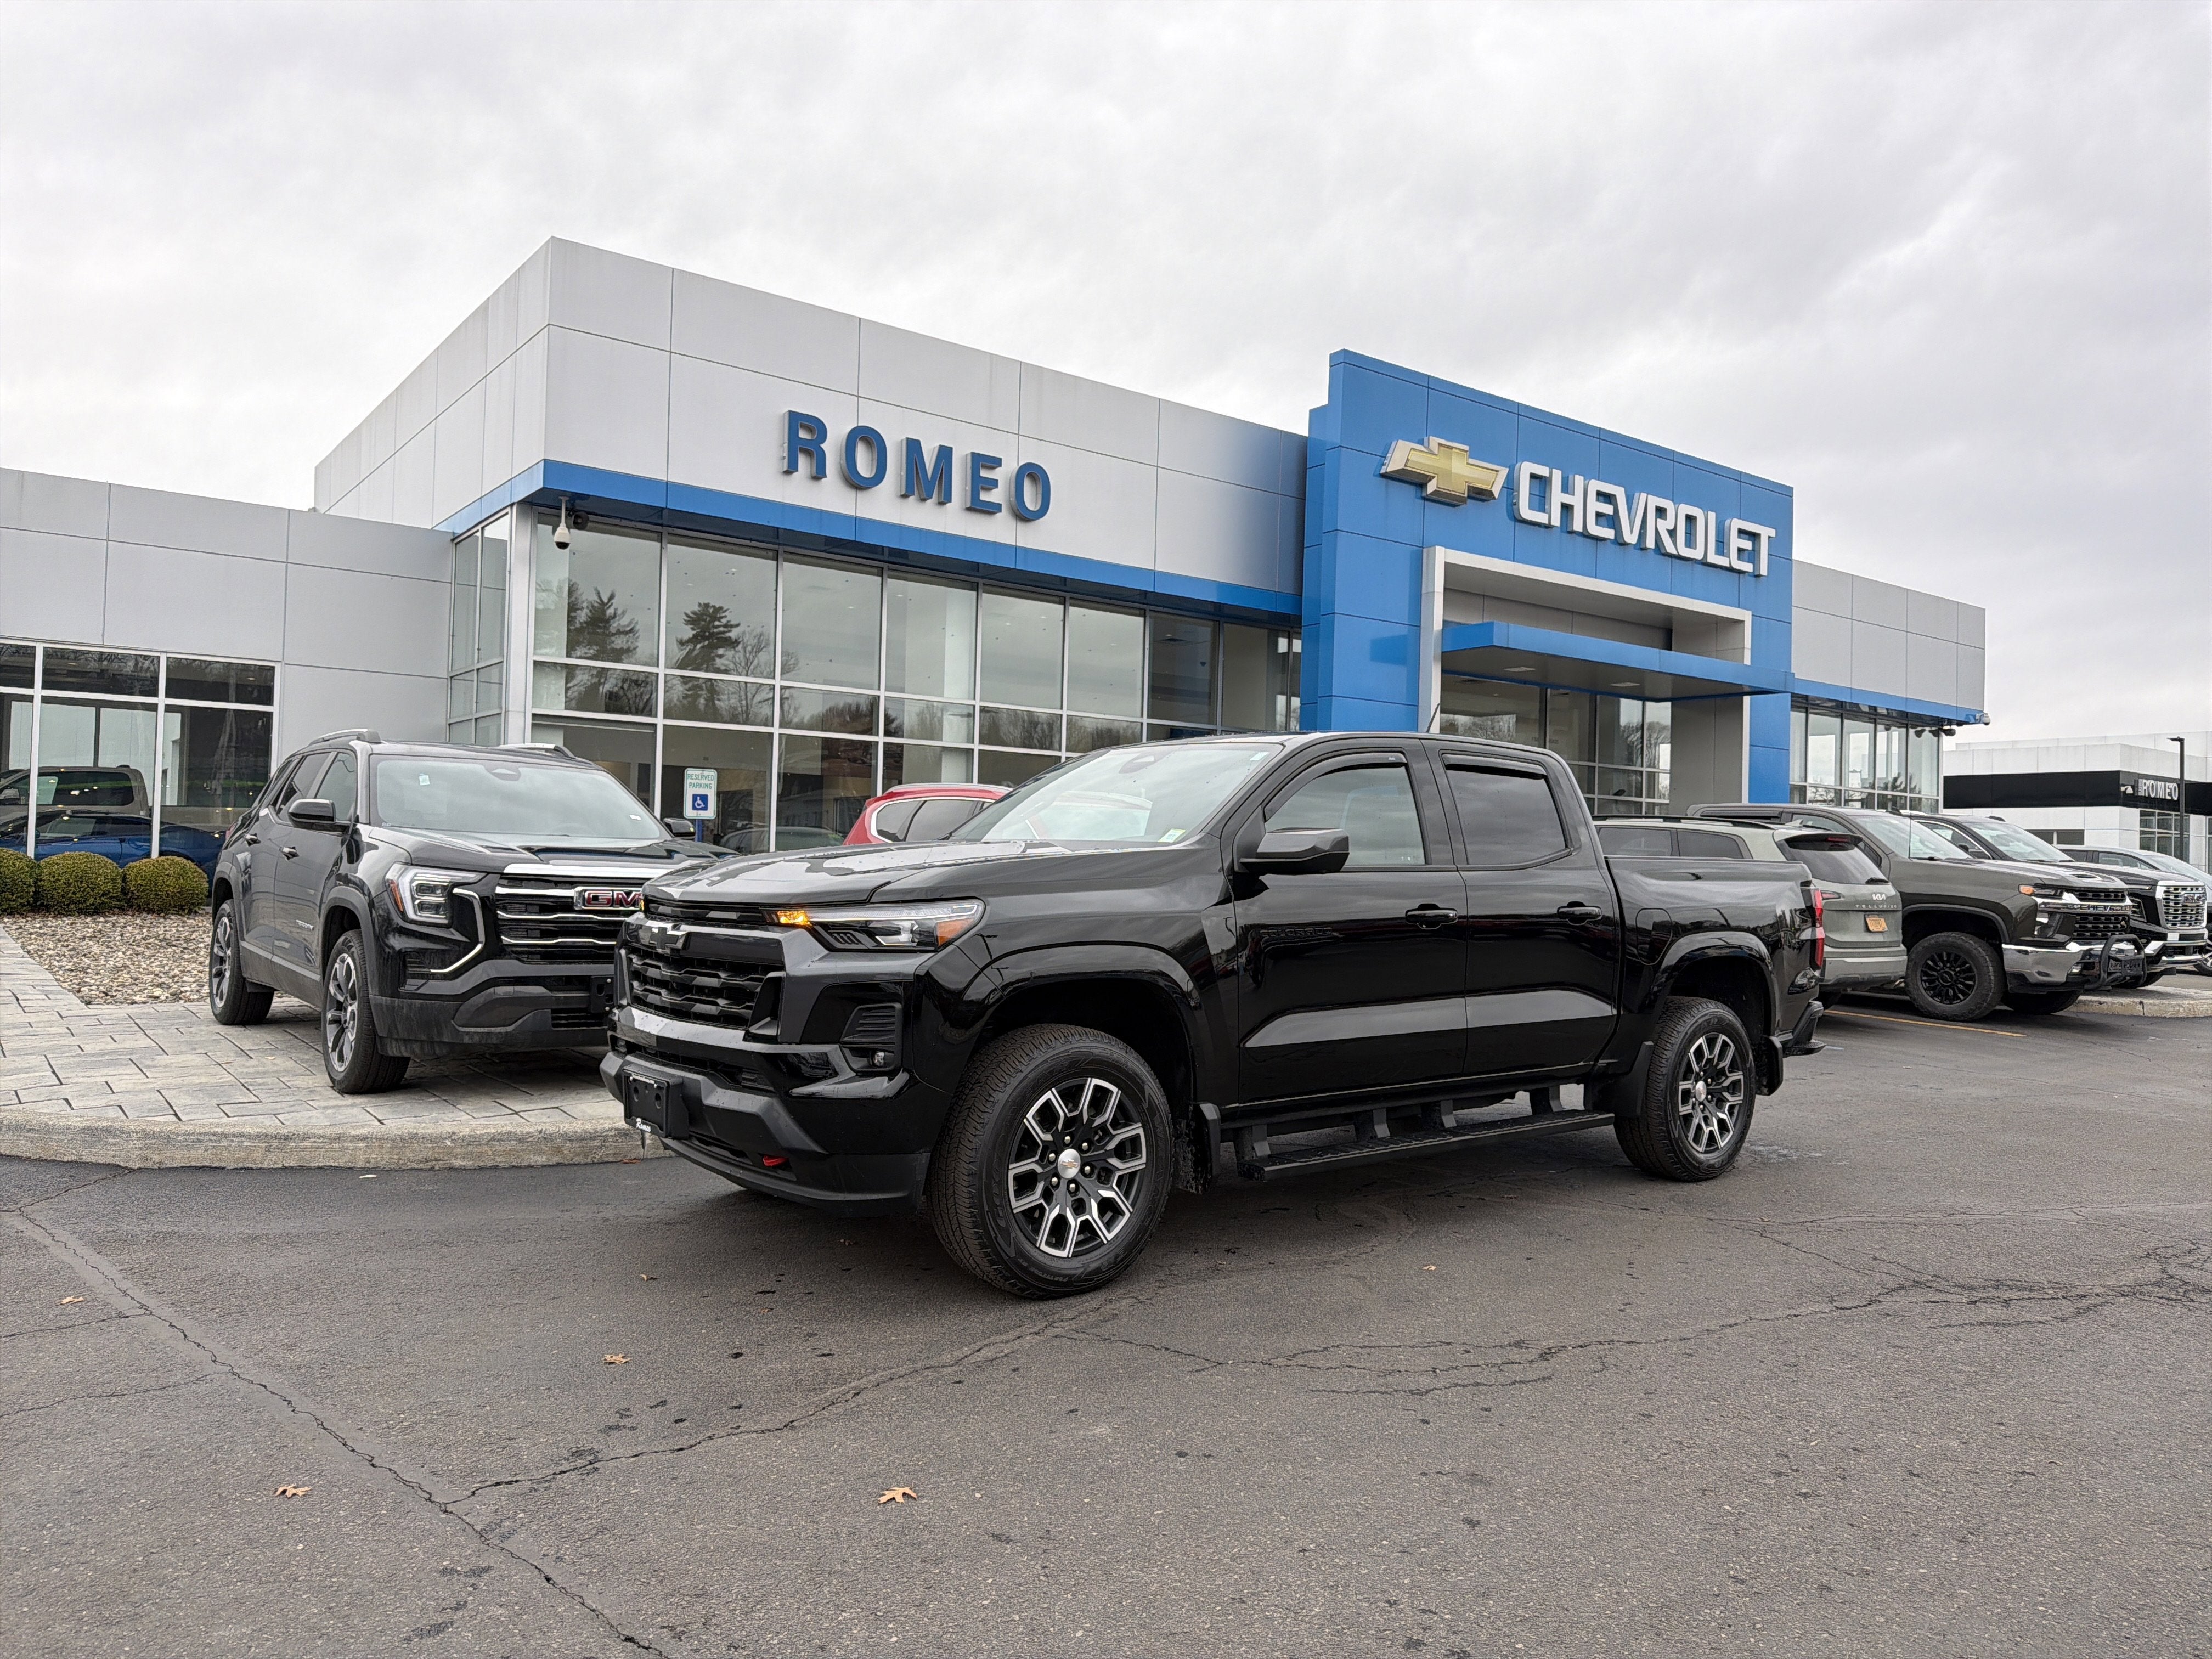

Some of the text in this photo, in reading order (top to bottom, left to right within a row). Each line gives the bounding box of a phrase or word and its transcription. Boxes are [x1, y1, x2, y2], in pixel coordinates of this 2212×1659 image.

[783, 409, 1051, 521] ROMEO
[1513, 461, 1776, 577] CHEVROLET
[2139, 778, 2179, 800] ROMEO
[585, 890, 642, 907] GM
[1260, 928, 1333, 937] COLORADO
